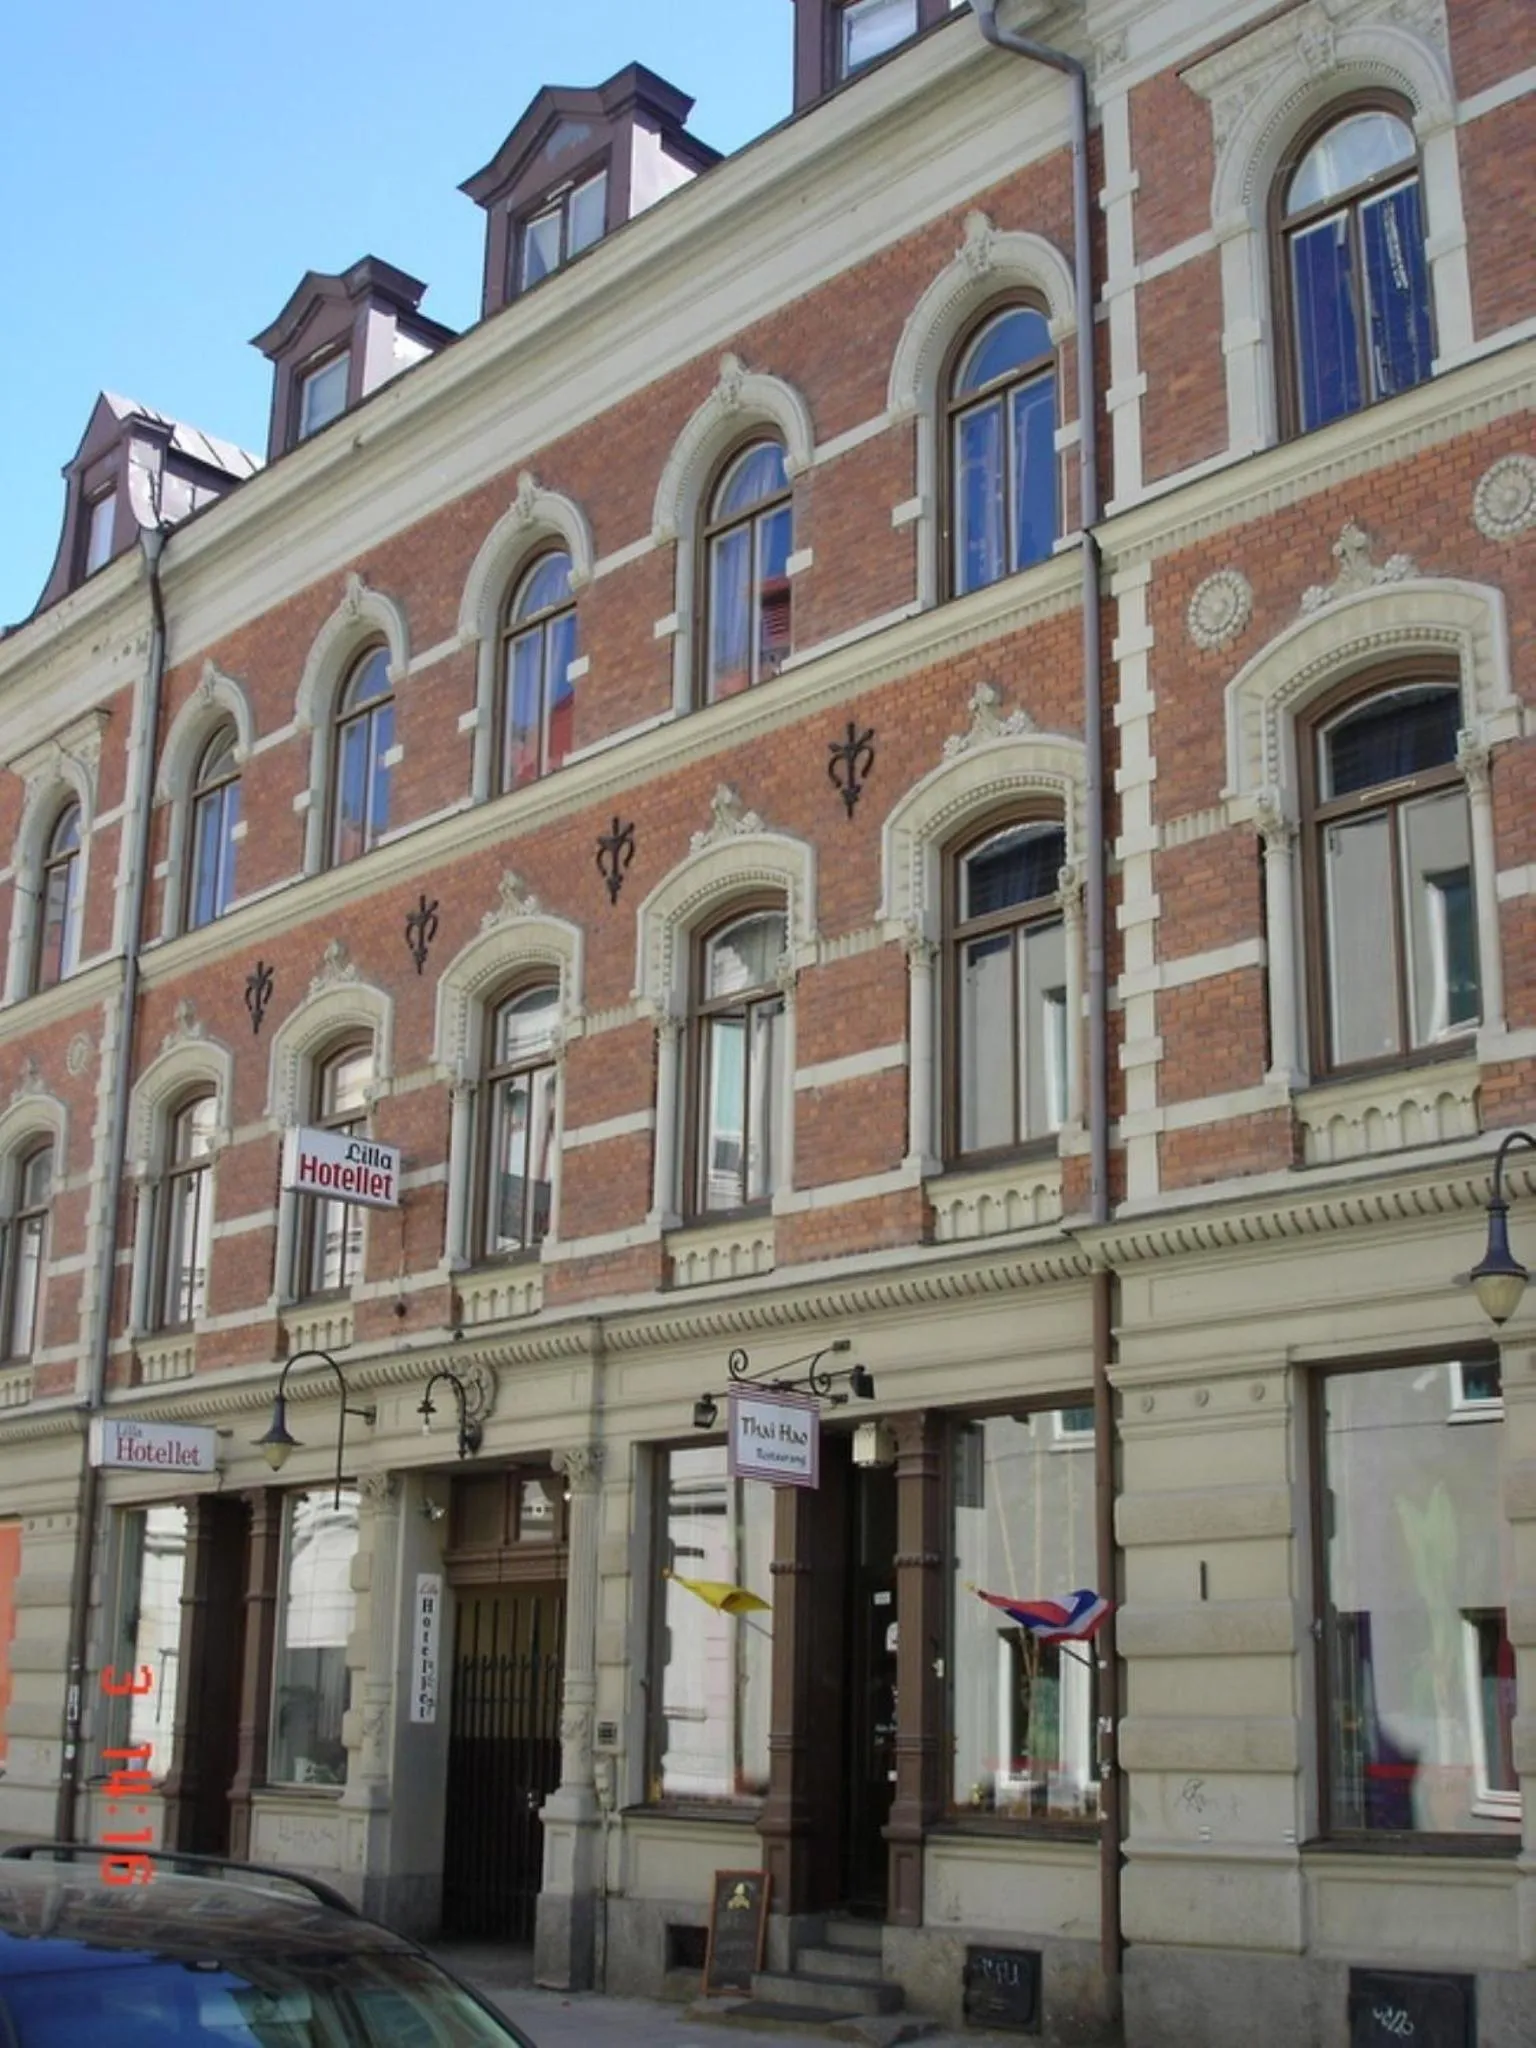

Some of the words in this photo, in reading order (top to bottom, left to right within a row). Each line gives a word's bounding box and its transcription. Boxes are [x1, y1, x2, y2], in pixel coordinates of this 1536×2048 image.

[344, 1142, 393, 1170] Lilla
[300, 1152, 393, 1201] Hotellet
[116, 1436, 200, 1467] Hotellet
